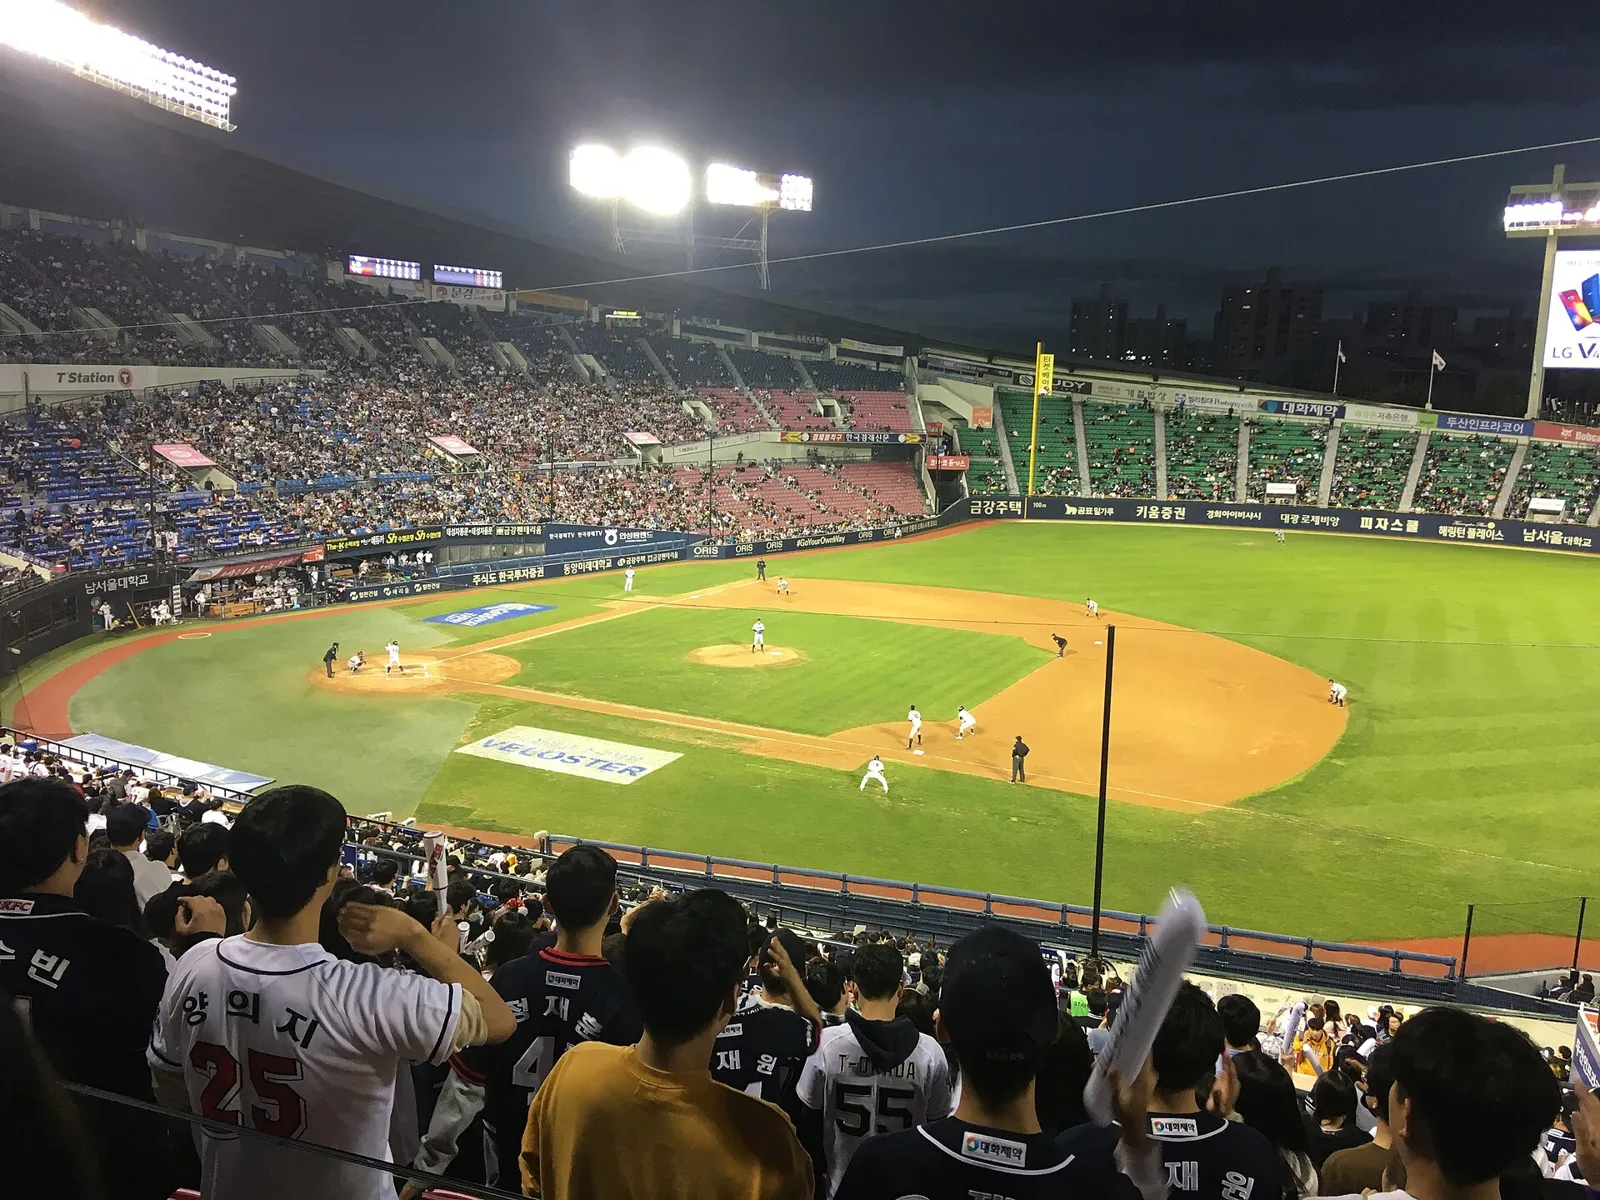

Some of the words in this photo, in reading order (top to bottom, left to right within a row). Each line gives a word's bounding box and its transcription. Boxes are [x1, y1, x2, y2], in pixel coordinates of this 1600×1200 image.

[1553, 347, 1573, 359] LG
[1282, 402, 1339, 417] 대화제약
[1446, 417, 1525, 434] 두산인프라코어
[846, 433, 890, 443] 한국경제신문
[1575, 431, 1600, 443] Bobca
[970, 500, 1022, 515] 금강주택
[1136, 505, 1186, 520] 키움증권
[858, 530, 873, 539] ORIS
[1438, 524, 1466, 539] 해링턴
[1466, 526, 1504, 541] 플레이스
[735, 543, 753, 554] ORIS
[766, 540, 783, 550] ORIS
[796, 535, 846, 548] #GoYourOwnWay
[694, 545, 718, 555] ORIS
[563, 559, 613, 575] 동양미래대학교
[472, 573, 497, 585] 주식도
[498, 567, 545, 582] 한국투자증권
[85, 574, 149, 595] 남서울대학교
[482, 738, 647, 777] VELOSTER
[183, 990, 320, 1049] 양의지
[189, 1041, 307, 1140] 25
[834, 1082, 915, 1137] 55
[1165, 1122, 1196, 1133] 대화제약
[980, 1141, 1023, 1160] 대화제약
